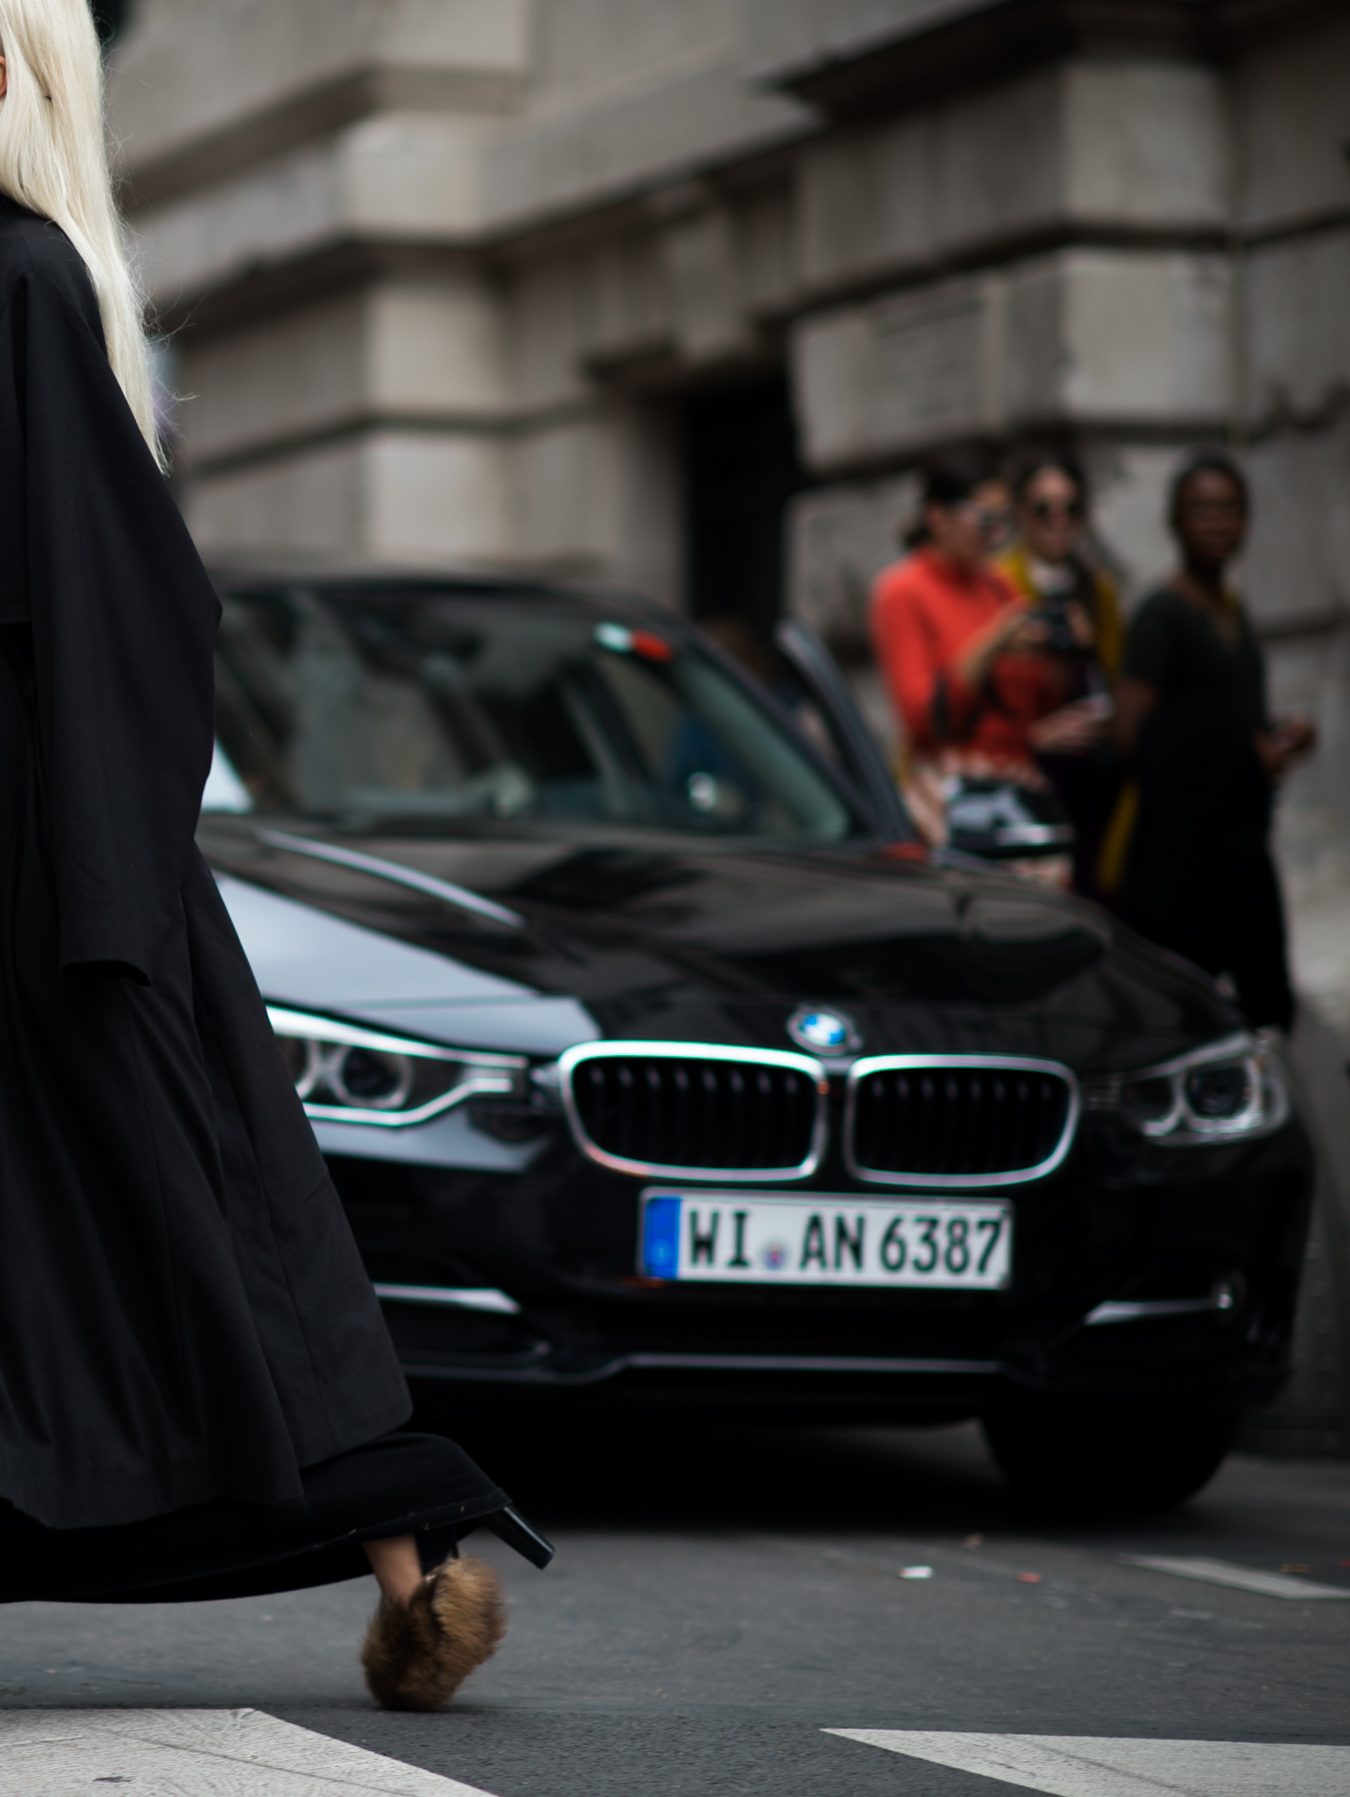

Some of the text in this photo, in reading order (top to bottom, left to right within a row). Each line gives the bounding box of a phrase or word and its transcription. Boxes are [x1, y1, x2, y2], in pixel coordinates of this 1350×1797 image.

[689, 1210, 751, 1267] WI
[800, 1213, 865, 1272] AN
[878, 1216, 1003, 1275] 6387
